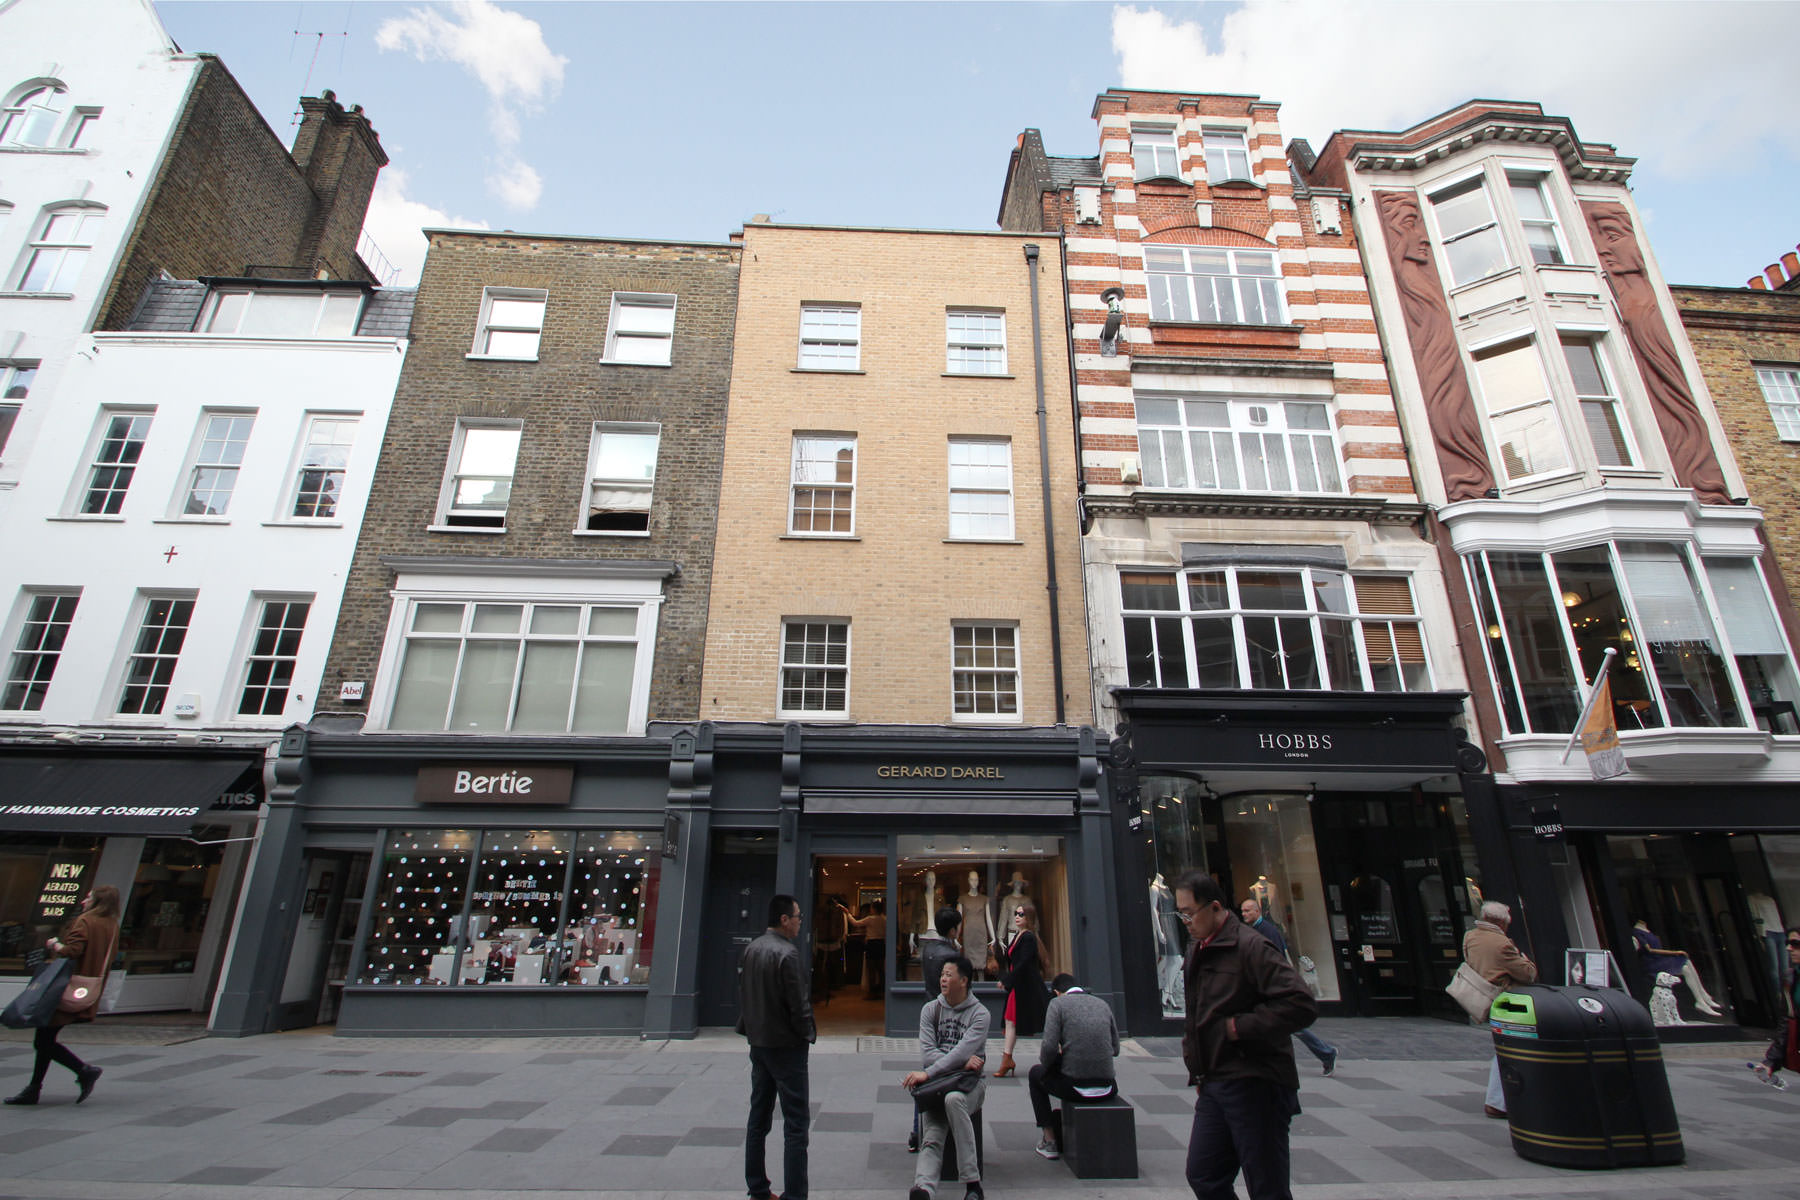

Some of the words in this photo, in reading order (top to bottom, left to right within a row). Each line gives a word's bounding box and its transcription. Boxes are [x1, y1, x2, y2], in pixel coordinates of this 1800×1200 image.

[342, 686, 363, 695] Abel
[1258, 733, 1332, 750] HOBBS
[877, 765, 947, 778] GERARD
[951, 767, 1005, 779] DAREL
[454, 769, 533, 794] Bertie
[4, 805, 101, 815] HANDMADE
[101, 806, 199, 816] COSMETICS
[1534, 824, 1562, 833] HOBBS
[50, 863, 84, 878] NEW
[43, 882, 80, 891] AERATED
[39, 894, 77, 904] MASSAGE
[42, 907, 65, 916] BARS
